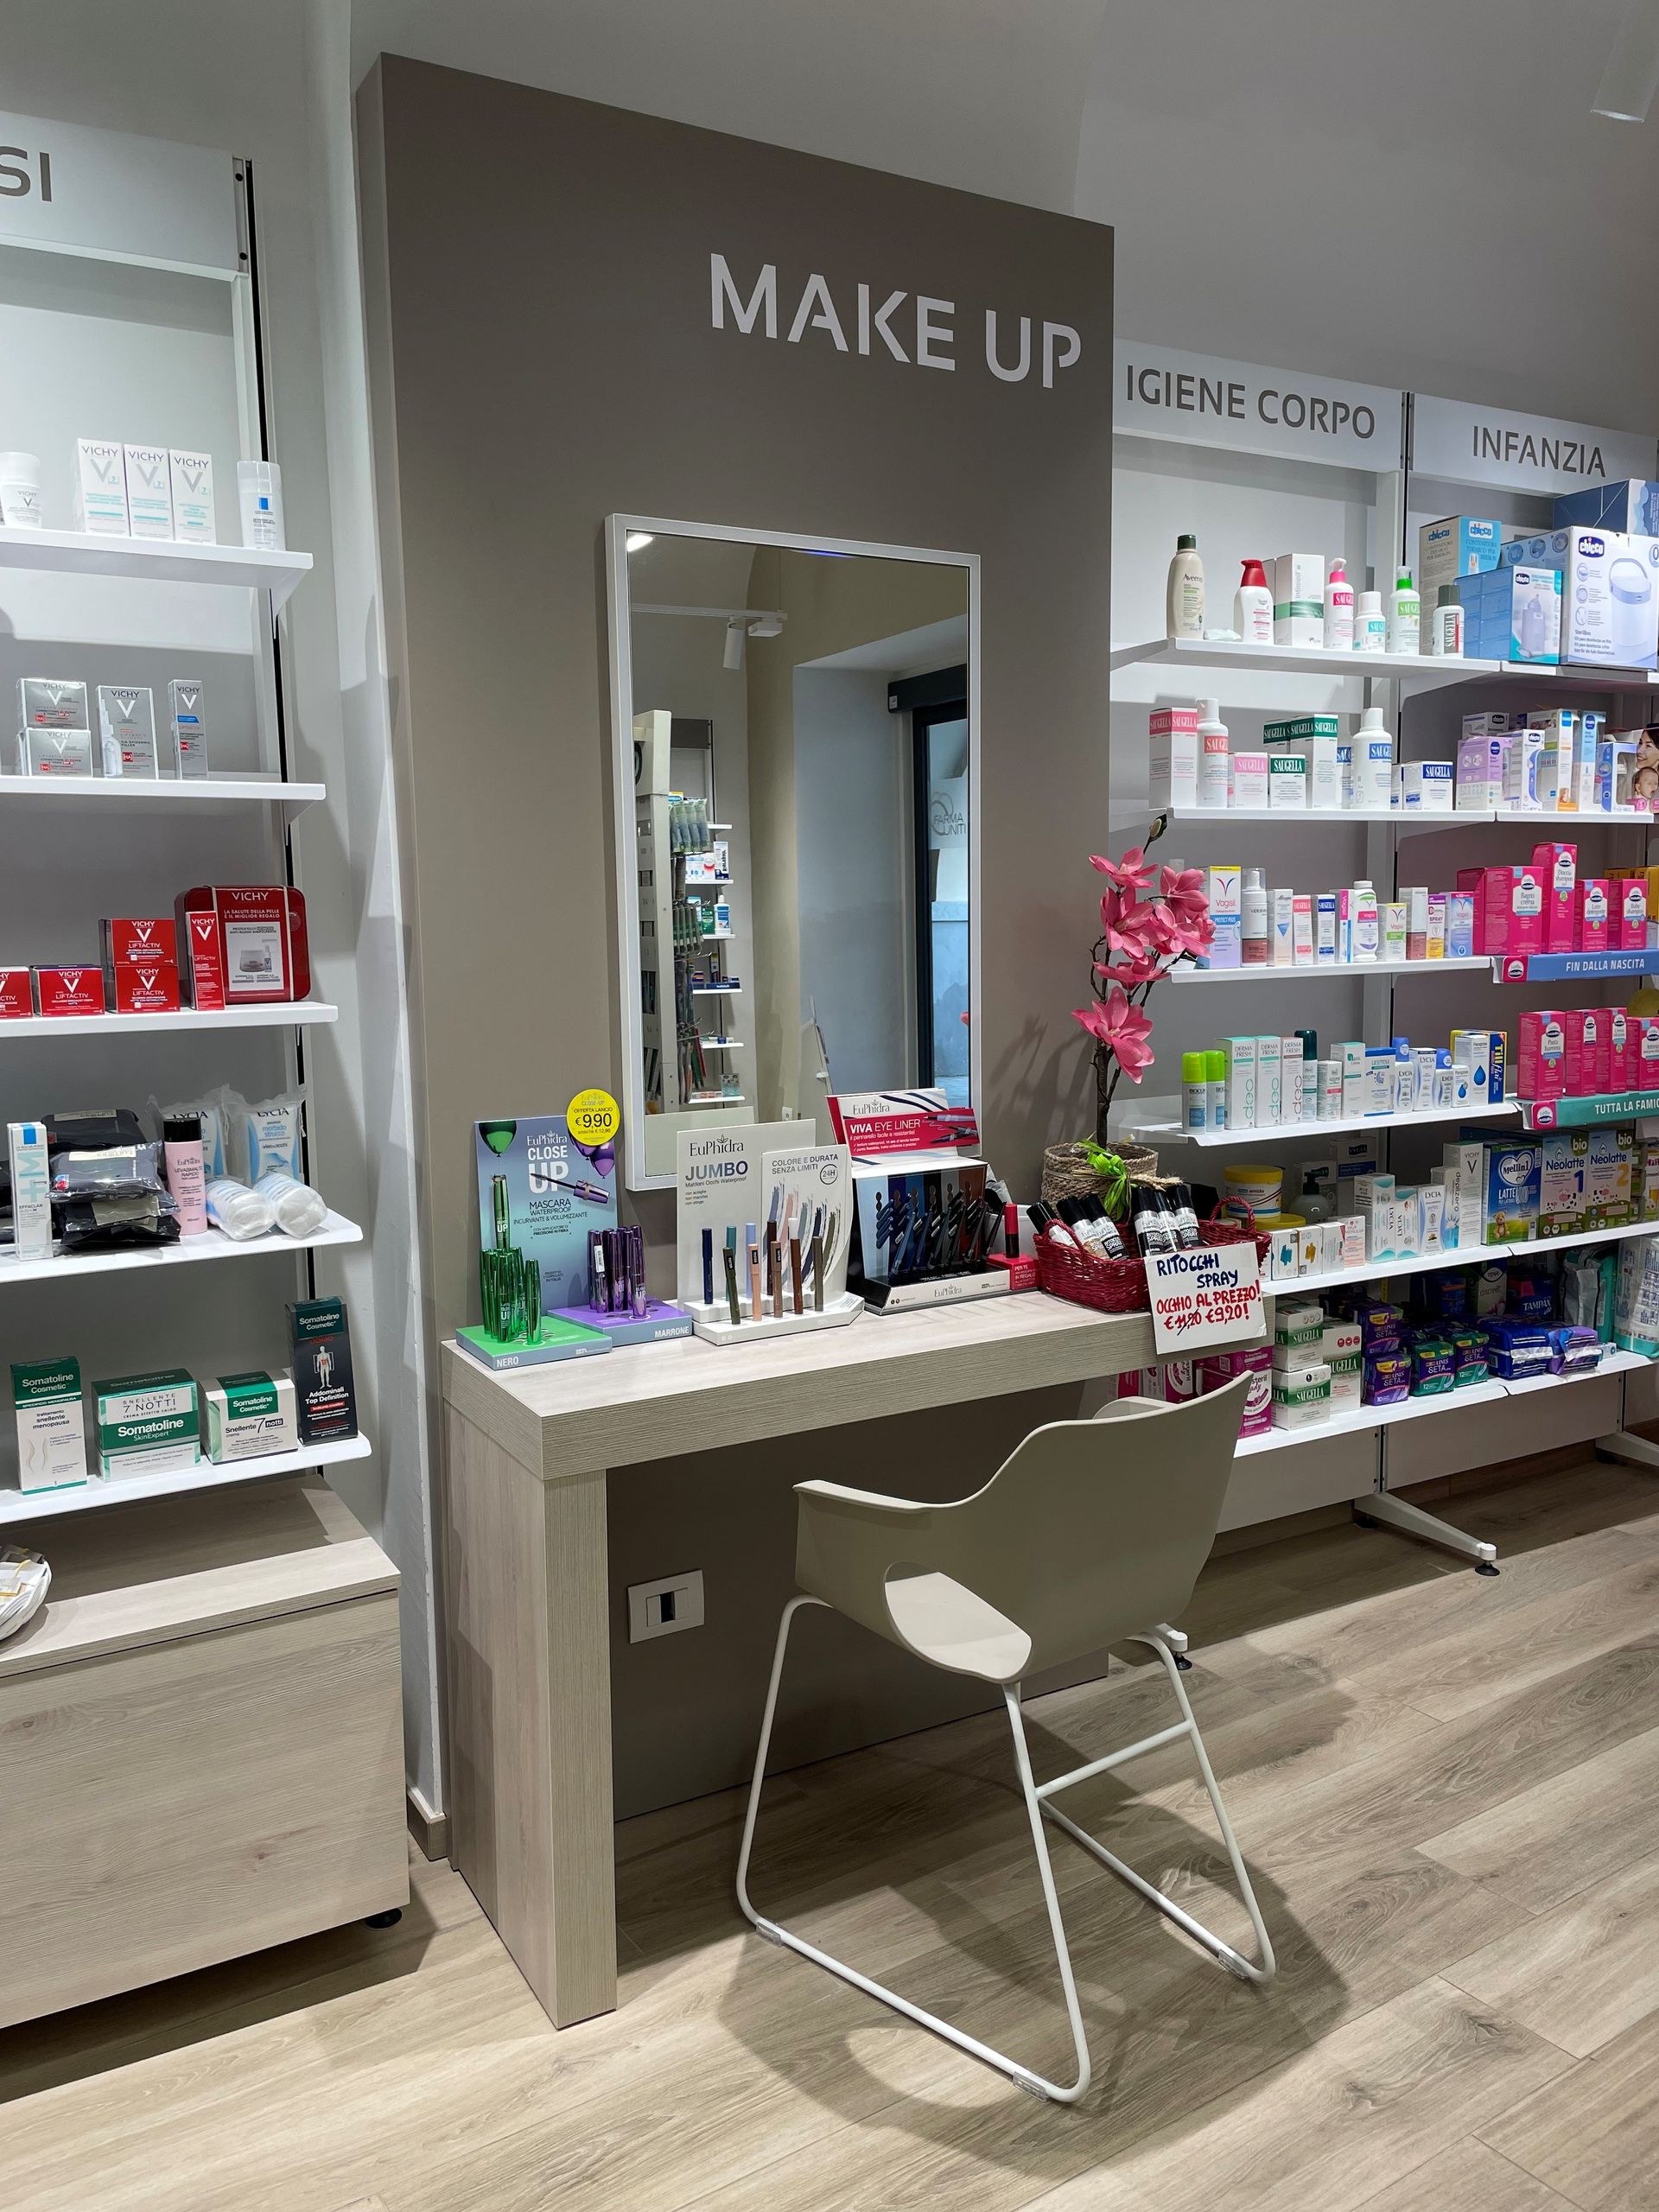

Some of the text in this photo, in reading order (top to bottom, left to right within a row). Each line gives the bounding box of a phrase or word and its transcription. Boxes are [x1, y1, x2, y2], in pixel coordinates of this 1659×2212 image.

[710, 252, 1082, 389] MAKE UP
[1127, 364, 1376, 439] IGIENE CORPO
[82, 445, 118, 457] VICHY
[130, 451, 164, 462] VICHY
[1473, 425, 1607, 478] INFANZIA
[175, 456, 209, 468] VICHY
[1428, 529, 1450, 541] chicco
[1470, 522, 1491, 536] chicco
[1579, 537, 1604, 555] chicco
[111, 690, 140, 698] VICHY
[1172, 715, 1197, 727] SAUGELLA
[1291, 721, 1314, 735] SAUGELLA
[1314, 721, 1338, 734] SAUGELLA
[1238, 760, 1264, 772] SAUGELLA
[1274, 760, 1302, 772] SAUGELLA
[1426, 766, 1451, 778] SAUGELLA
[232, 892, 269, 901] VICHY
[1216, 899, 1236, 908] Vagisil
[1566, 958, 1645, 972] FIN DALLA NASCITA
[257, 1108, 289, 1117] LYCIA
[853, 1102, 890, 1116] EuPhidra
[1595, 1103, 1622, 1115] TUTTA
[1624, 1101, 1634, 1112] LA
[575, 1113, 612, 1129] € 9,90
[850, 1118, 921, 1134] VIVA EYE LINER
[526, 1132, 568, 1147] EuPhidra
[1573, 1139, 1587, 1150] bio
[1618, 1134, 1632, 1145] bio
[528, 1145, 568, 1161] CLOSE
[690, 1139, 744, 1157] EuPhidra
[772, 1158, 802, 1167] COLORE
[810, 1154, 838, 1163] DURATA
[1546, 1158, 1585, 1171] Neolatte
[1590, 1152, 1627, 1165] Neolatte
[685, 1160, 748, 1181] JUMBO
[772, 1163, 818, 1174] SENZA LIMITI
[528, 1160, 569, 1194] UP
[1573, 1169, 1585, 1193] 1
[1616, 1163, 1630, 1187] 2
[1498, 1187, 1516, 1199] LATTE
[529, 1198, 572, 1210] MASCARA
[530, 1206, 572, 1217] WATERPROOF
[513, 1217, 545, 1225] INCURVANTE
[550, 1211, 588, 1221] VOLUMIZZANTE
[497, 1224, 508, 1233] UP
[1157, 1253, 1220, 1276] RITOCCHI
[1197, 1269, 1238, 1288] SPRAY
[934, 1287, 963, 1298] EuPhidra
[1156, 1279, 1262, 1314] OCCHIO AL PREZZO!
[1523, 1299, 1552, 1311] TAMPAX
[299, 1313, 340, 1325] Somatoline
[306, 1322, 334, 1331] Cosmetic
[654, 1326, 690, 1338] MARRONE
[1293, 1328, 1319, 1343] SAUGELLA
[497, 1356, 518, 1368] NERO
[1328, 1358, 1357, 1375] AUGELLA
[1427, 1364, 1446, 1373] SETA
[22, 1373, 74, 1387] Somatoline
[1383, 1377, 1401, 1386] SETA
[31, 1383, 67, 1394] Cosmetic
[308, 1386, 345, 1398] Addominali
[1296, 1387, 1324, 1402] SAUGELLA
[123, 1393, 175, 1406] SNELLENTE
[232, 1396, 273, 1408] Somatoline
[319, 1392, 349, 1402] Definition
[136, 1398, 176, 1411] NOTTI
[239, 1404, 267, 1413] Cosmetic
[36, 1408, 64, 1417] trattamento
[36, 1414, 66, 1423] snellente
[33, 1419, 70, 1430] menopausa
[118, 1419, 184, 1437] Somatoline
[226, 1417, 283, 1433] Snellente 7 notti
[133, 1431, 168, 1441] SkinExpert
